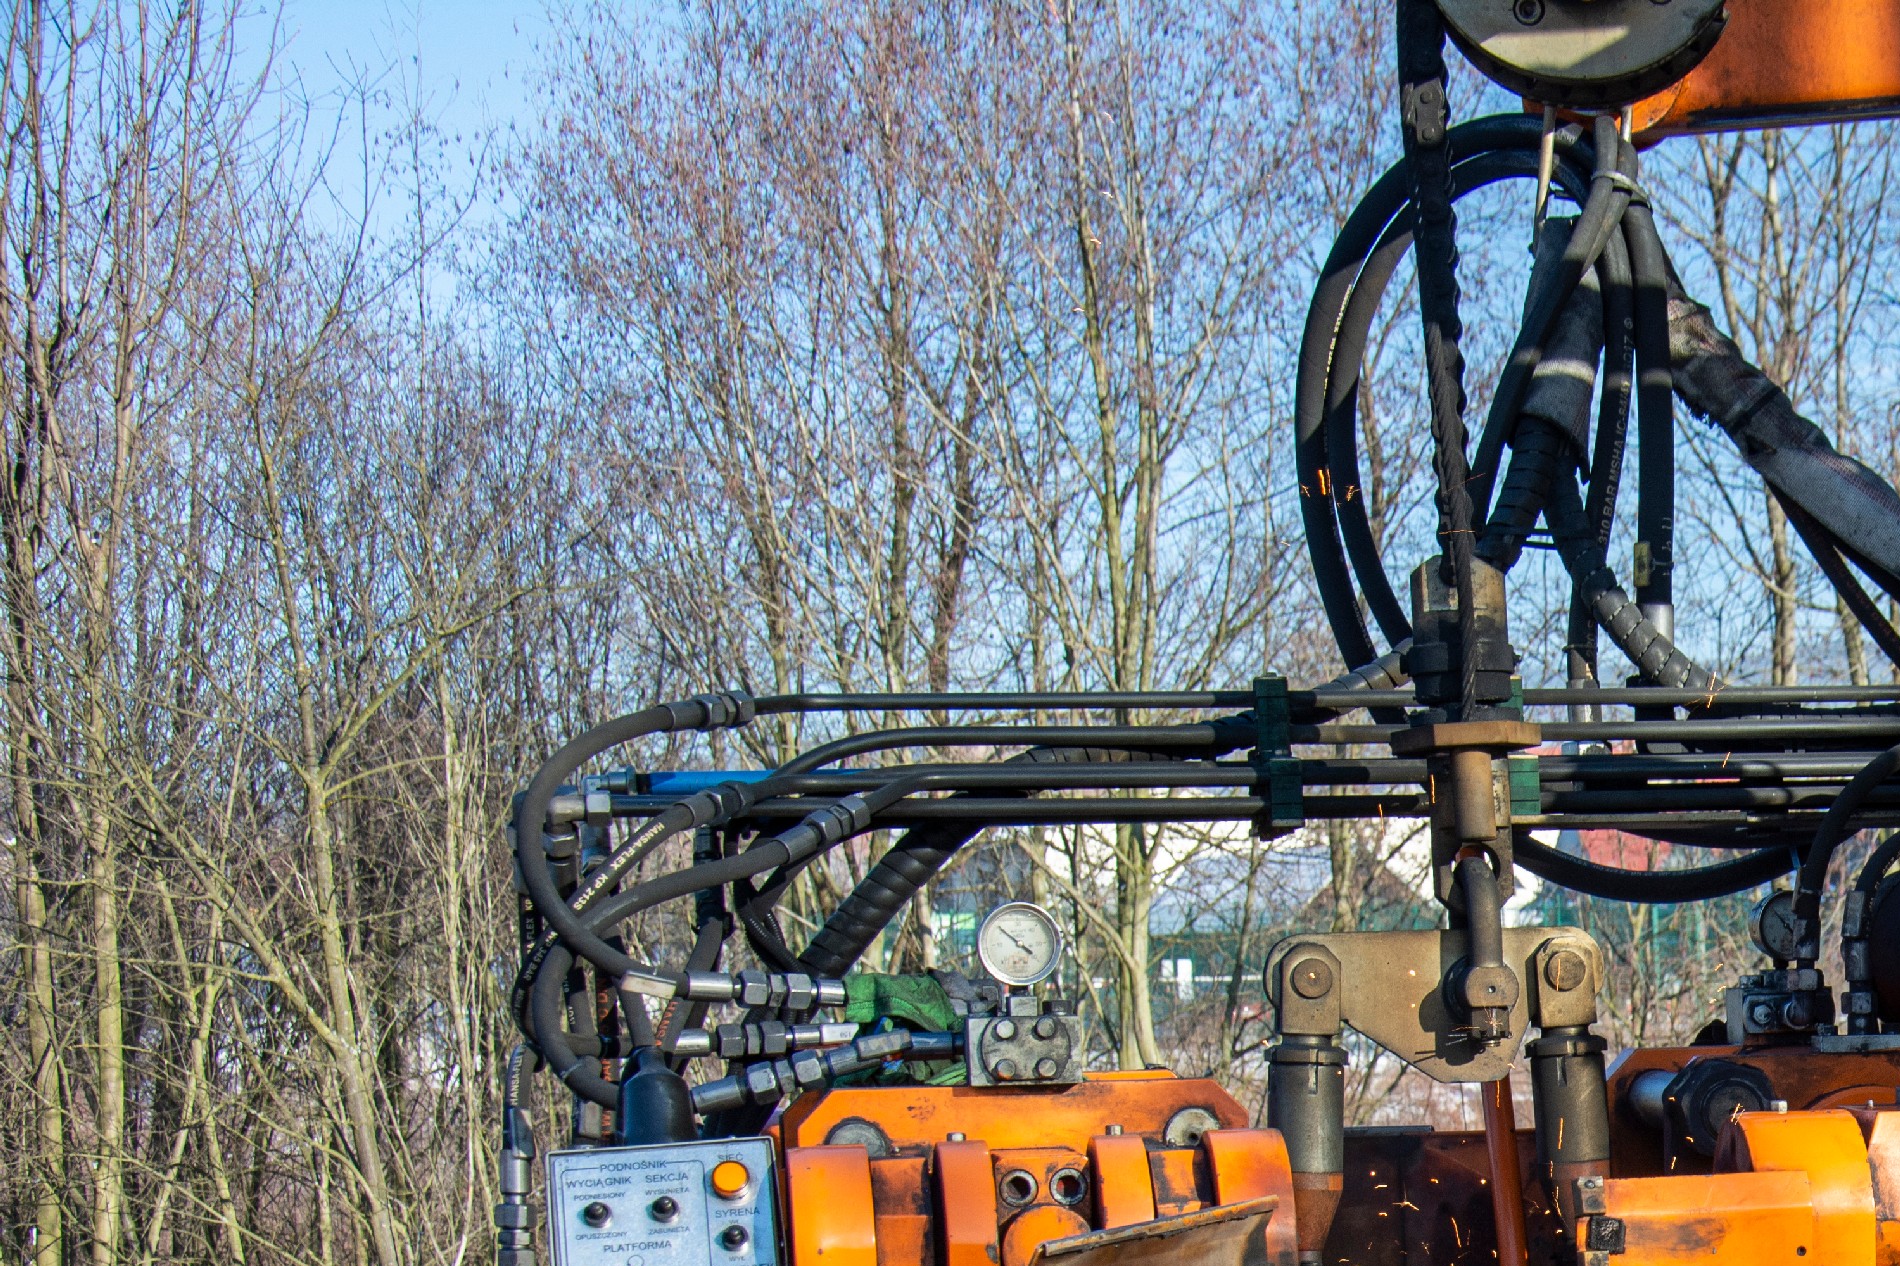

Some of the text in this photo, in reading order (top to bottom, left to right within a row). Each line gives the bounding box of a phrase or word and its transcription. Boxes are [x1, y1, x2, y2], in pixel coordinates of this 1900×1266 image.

[1608, 440, 1625, 484] MSHA
[1601, 485, 1617, 519] BAR
[571, 822, 665, 911] HANSA-FLEX KP 213S
[510, 1054, 526, 1106] HANSA-FLE
[600, 1160, 667, 1172] PODNOŚNIK
[566, 1176, 631, 1189] WYCIĄGNIK
[645, 1172, 688, 1183] SEKCJA
[574, 1192, 626, 1201] PODNIESIONY
[716, 1207, 760, 1218] SYRENA
[575, 1231, 627, 1240] OPUSZCZONY
[603, 1240, 672, 1253] PLATFORMA
